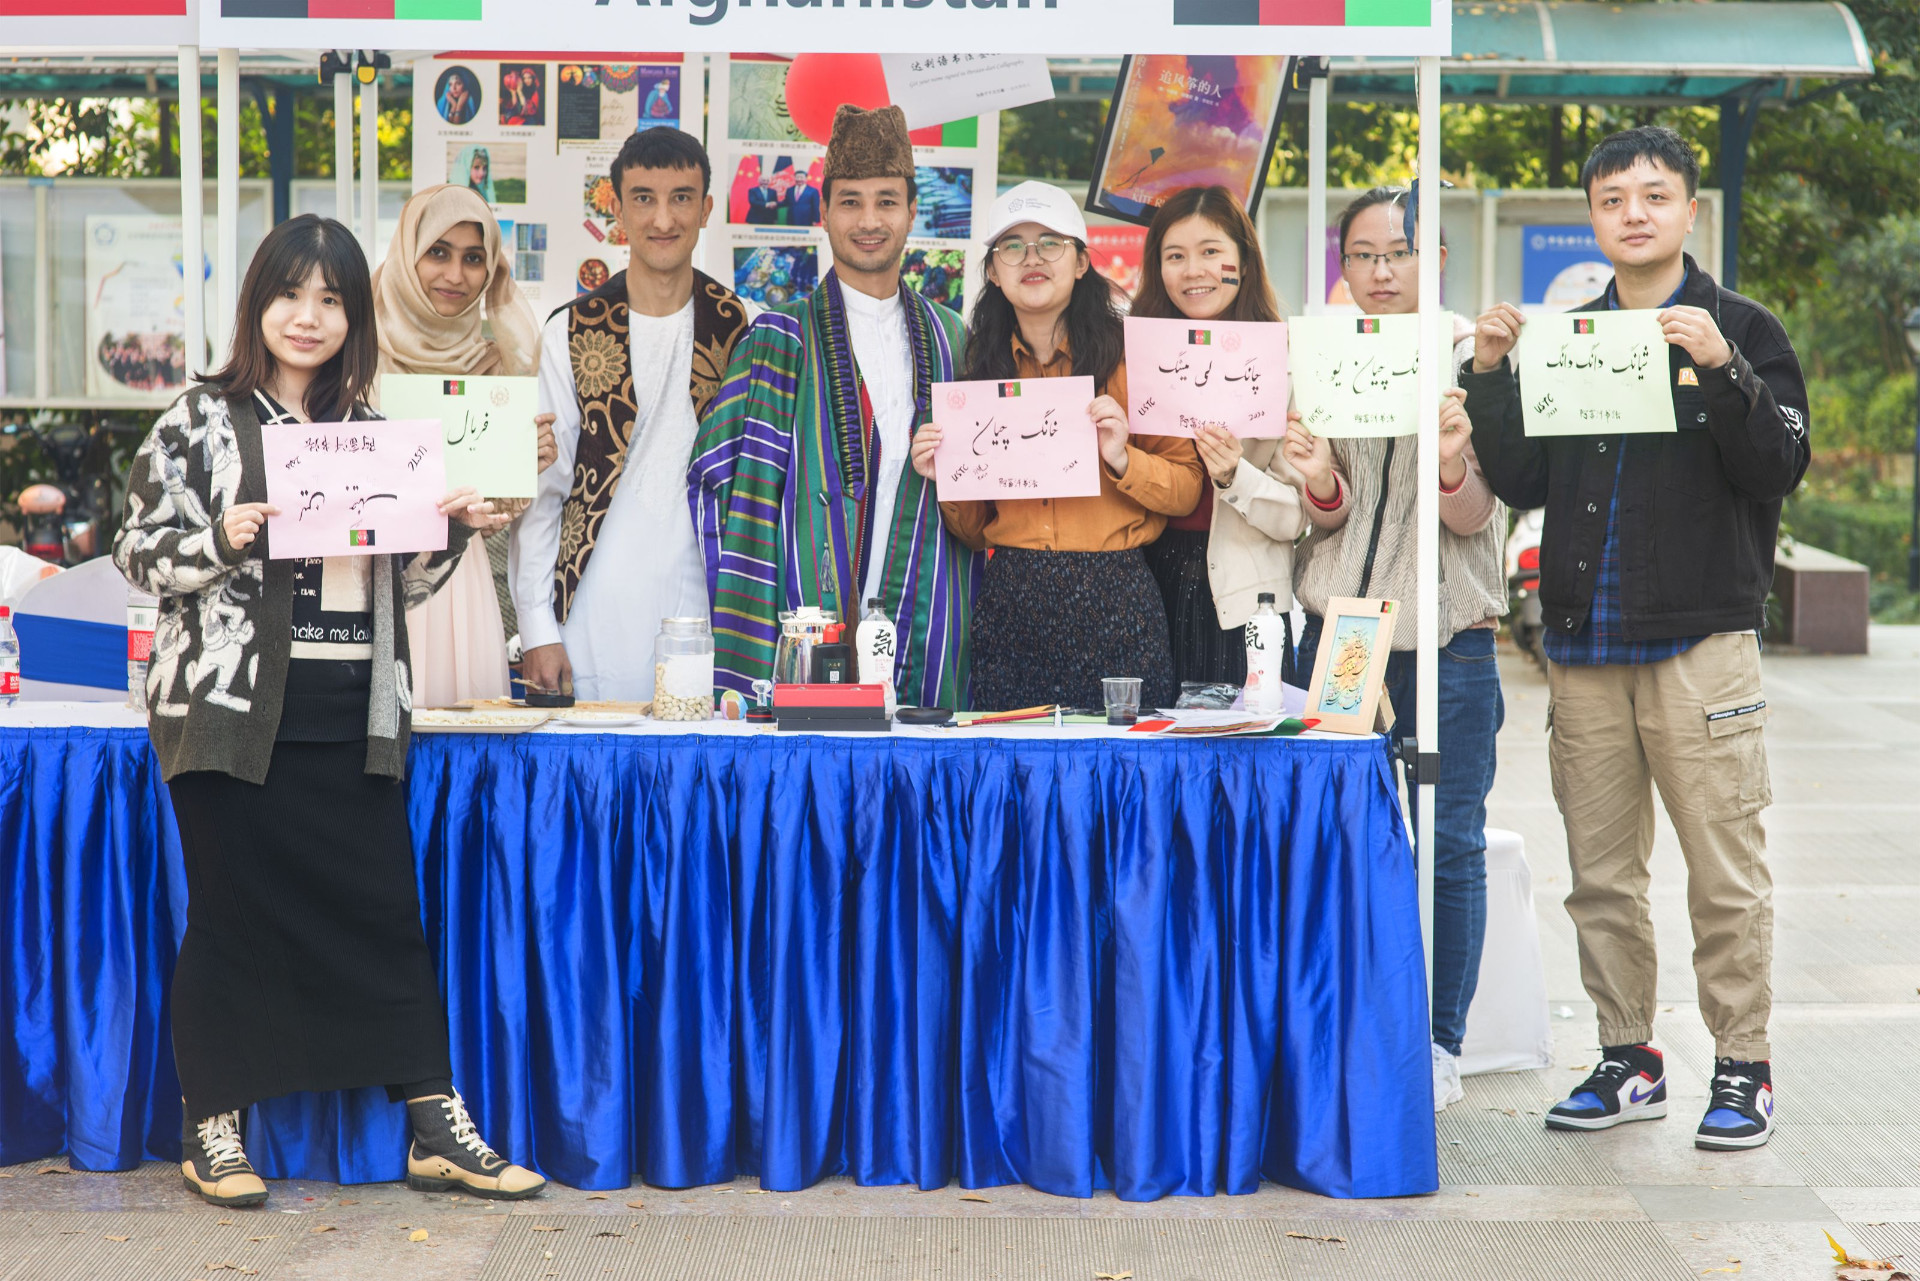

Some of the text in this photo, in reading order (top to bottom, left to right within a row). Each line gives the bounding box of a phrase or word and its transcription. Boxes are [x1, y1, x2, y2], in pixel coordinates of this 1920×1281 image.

[1158, 69, 1222, 99] 追风筝的人
[1138, 397, 1155, 416] USTC
[1533, 393, 1554, 414] USTC
[1308, 405, 1324, 424] USTC
[447, 409, 489, 451] فریال
[305, 435, 376, 453] 阿富汗书法
[407, 445, 428, 471] USTC
[951, 463, 969, 482] USTC
[329, 627, 350, 641] me
